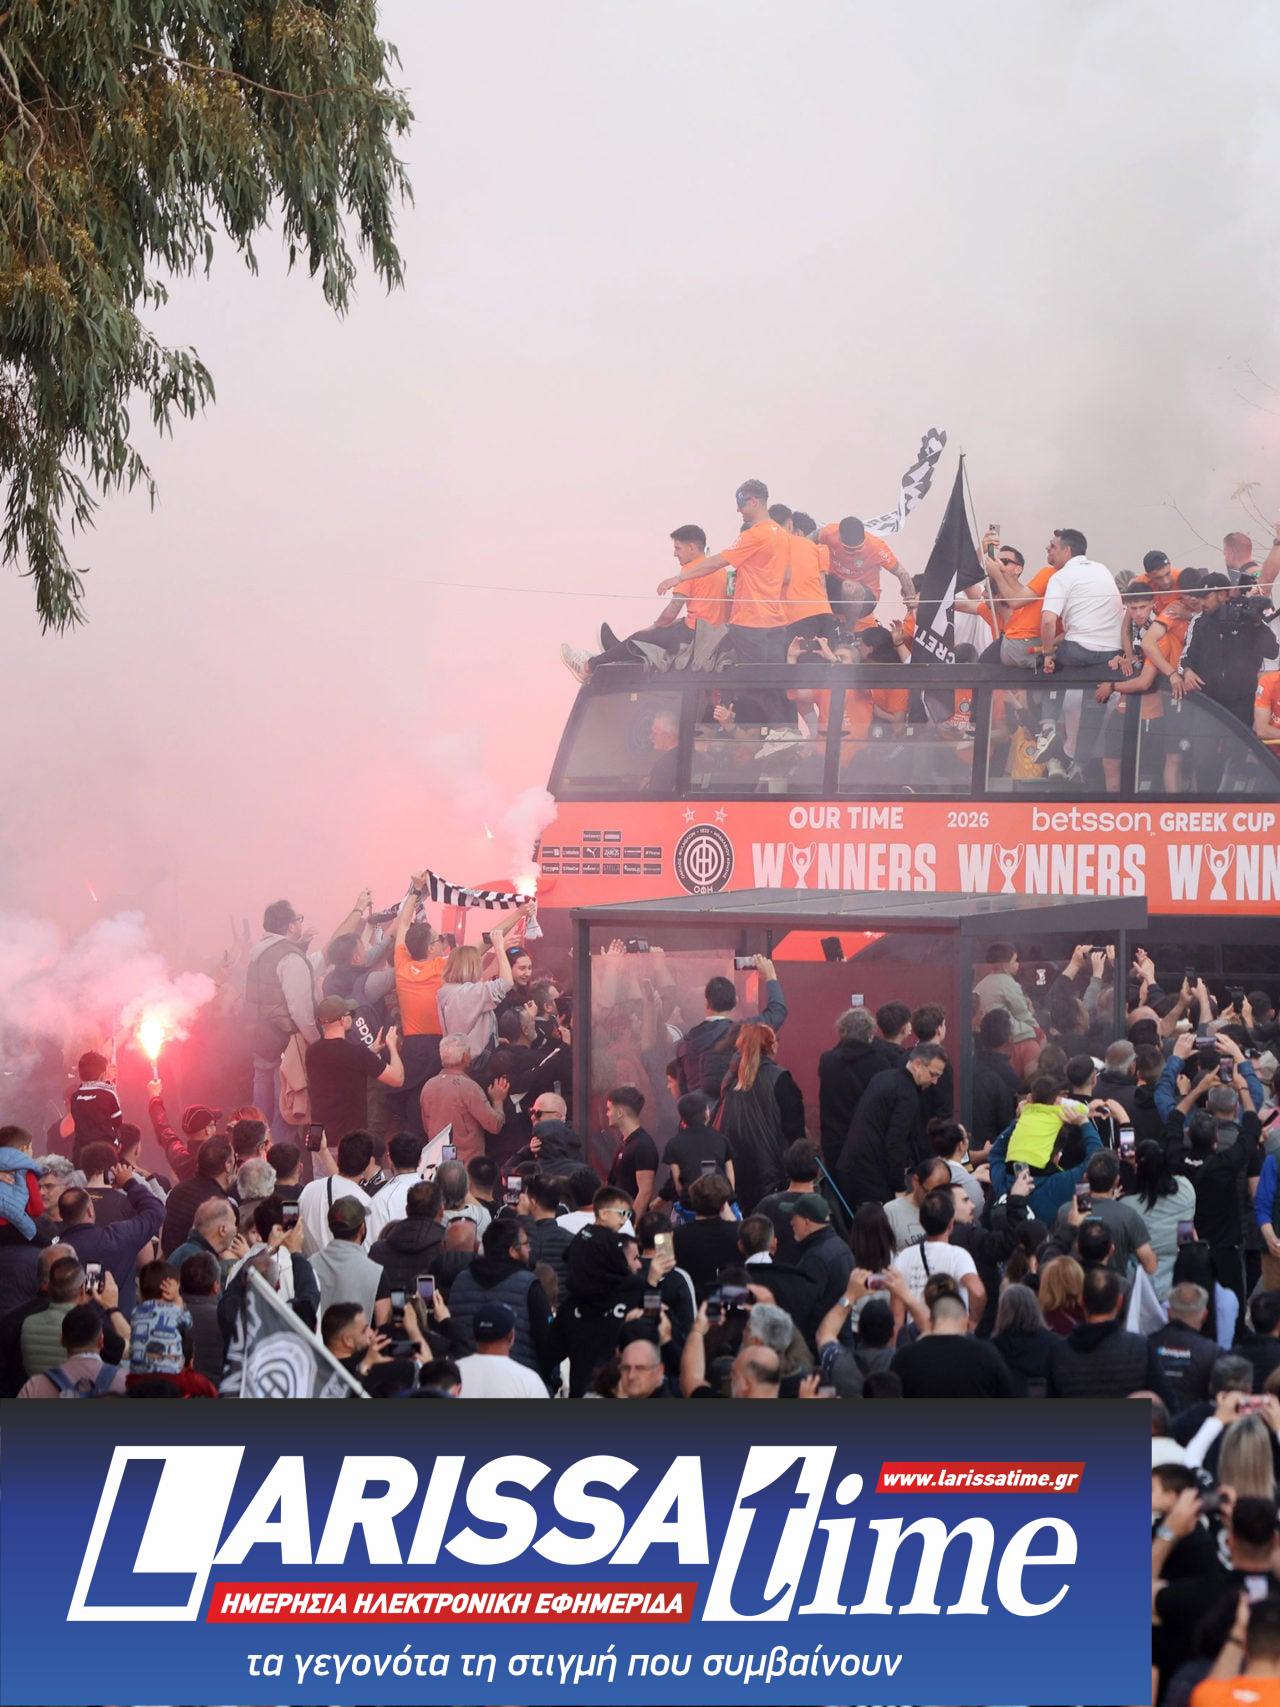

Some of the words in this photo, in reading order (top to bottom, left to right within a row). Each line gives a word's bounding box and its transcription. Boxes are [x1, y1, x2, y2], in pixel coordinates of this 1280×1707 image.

[789, 806, 841, 830] OUR
[848, 806, 904, 830] TIME
[947, 811, 989, 829] 2026
[1032, 807, 1151, 832] betsson
[1159, 812, 1228, 832] GREEK
[1233, 812, 1276, 832] CUP
[752, 842, 936, 892] WINNERS
[958, 842, 1145, 896] WINNERS
